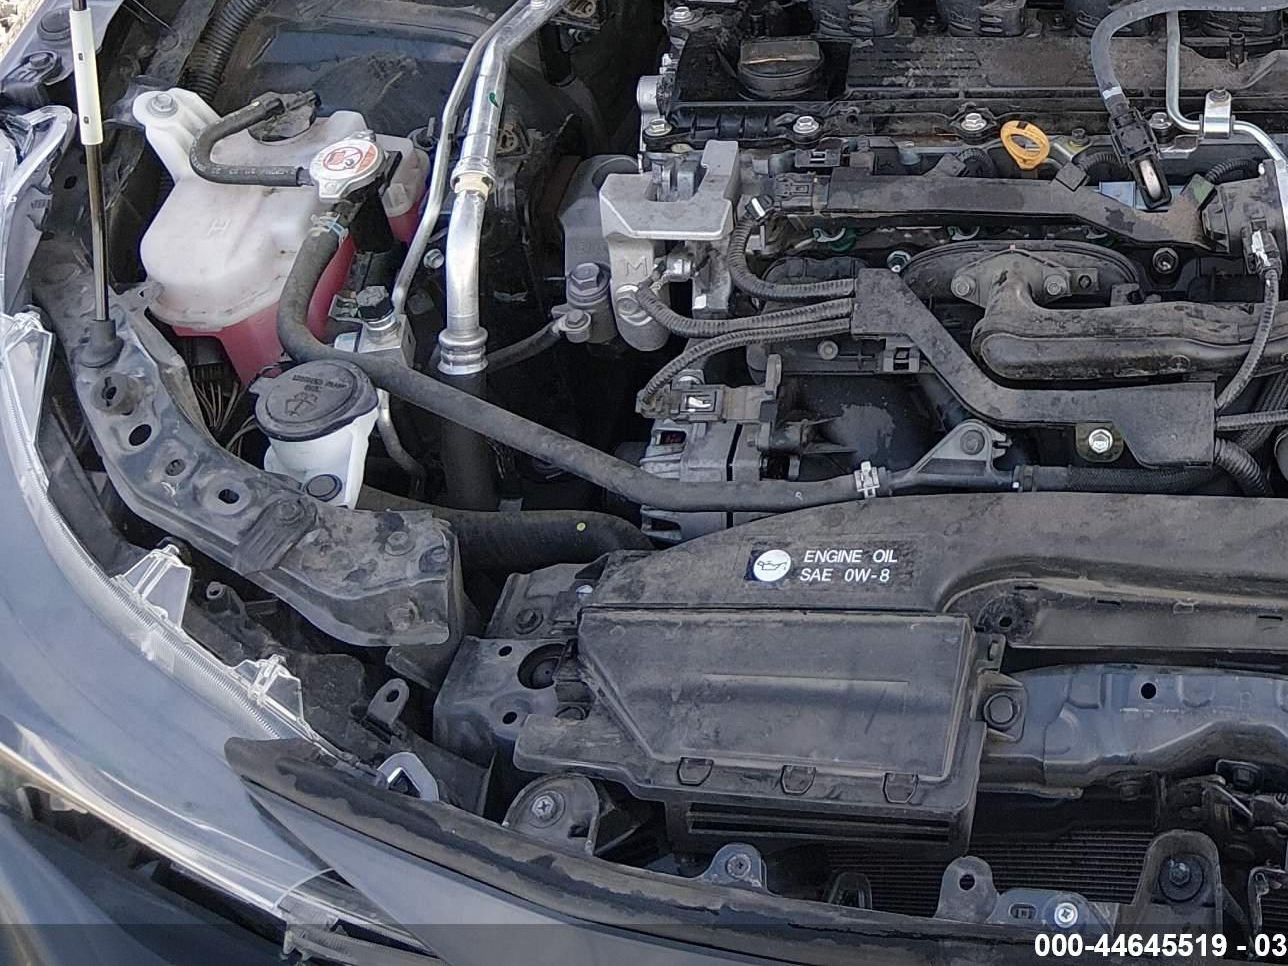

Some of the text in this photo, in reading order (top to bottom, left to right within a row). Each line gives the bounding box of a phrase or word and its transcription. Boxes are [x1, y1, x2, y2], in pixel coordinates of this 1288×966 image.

[803, 549, 898, 563] ENGINE OIL
[800, 568, 890, 582] SAE 0W-8
